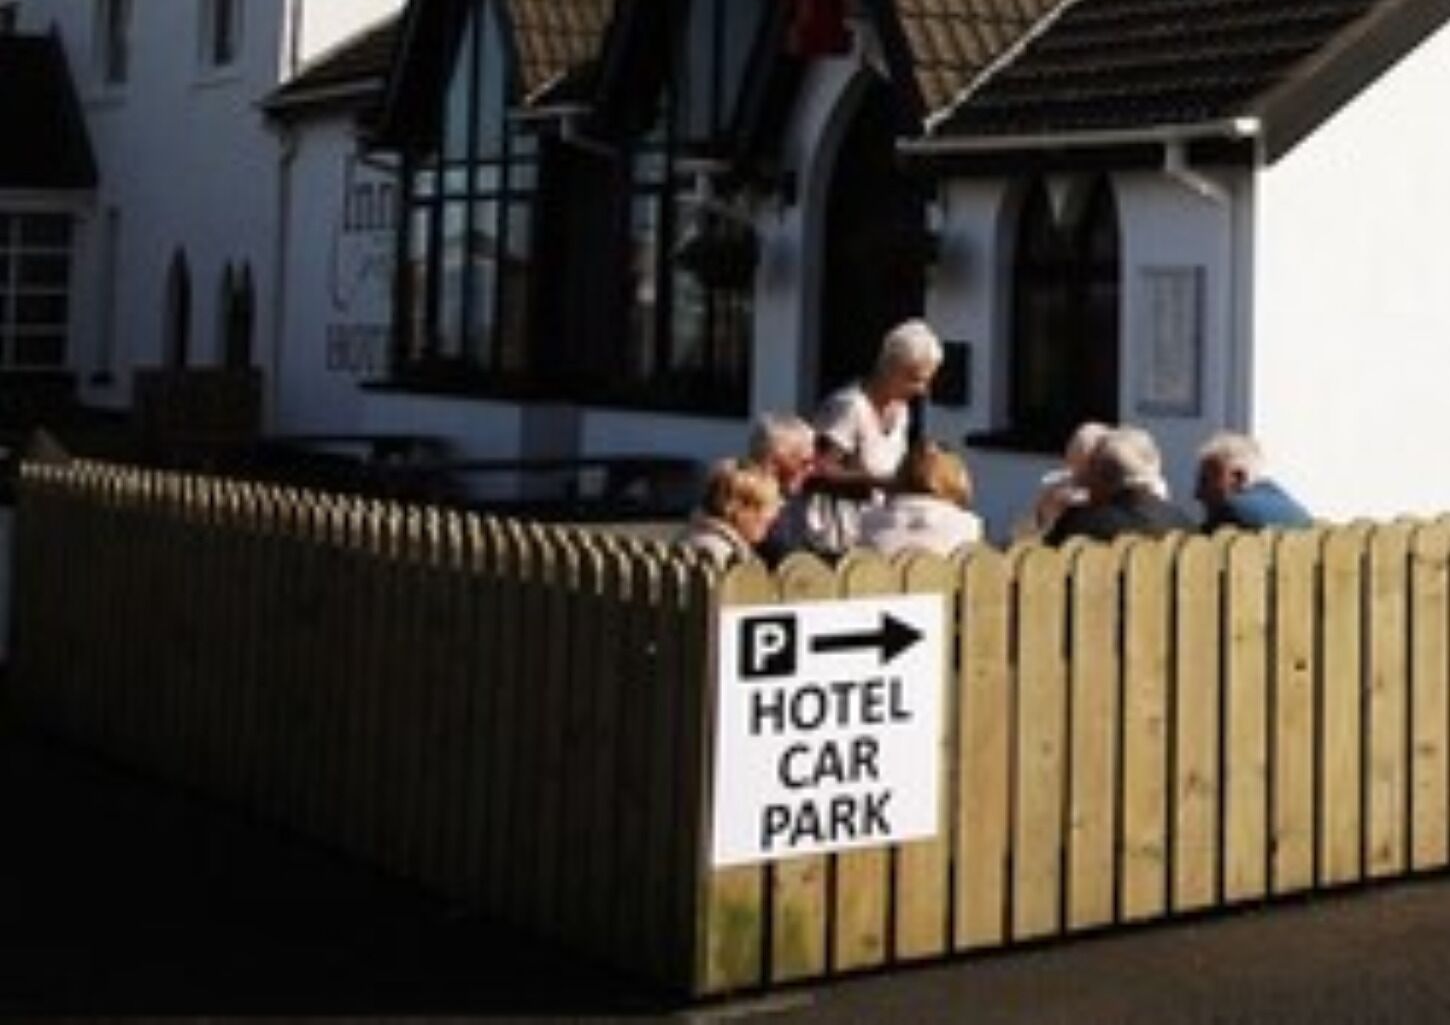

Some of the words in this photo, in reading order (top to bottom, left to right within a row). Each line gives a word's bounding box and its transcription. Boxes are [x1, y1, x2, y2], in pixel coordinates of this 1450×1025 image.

[326, 322, 390, 374] HOT
[753, 623, 787, 672] P
[749, 677, 914, 736] HOTEL
[777, 735, 879, 790] CAR
[760, 789, 892, 851] PARK
